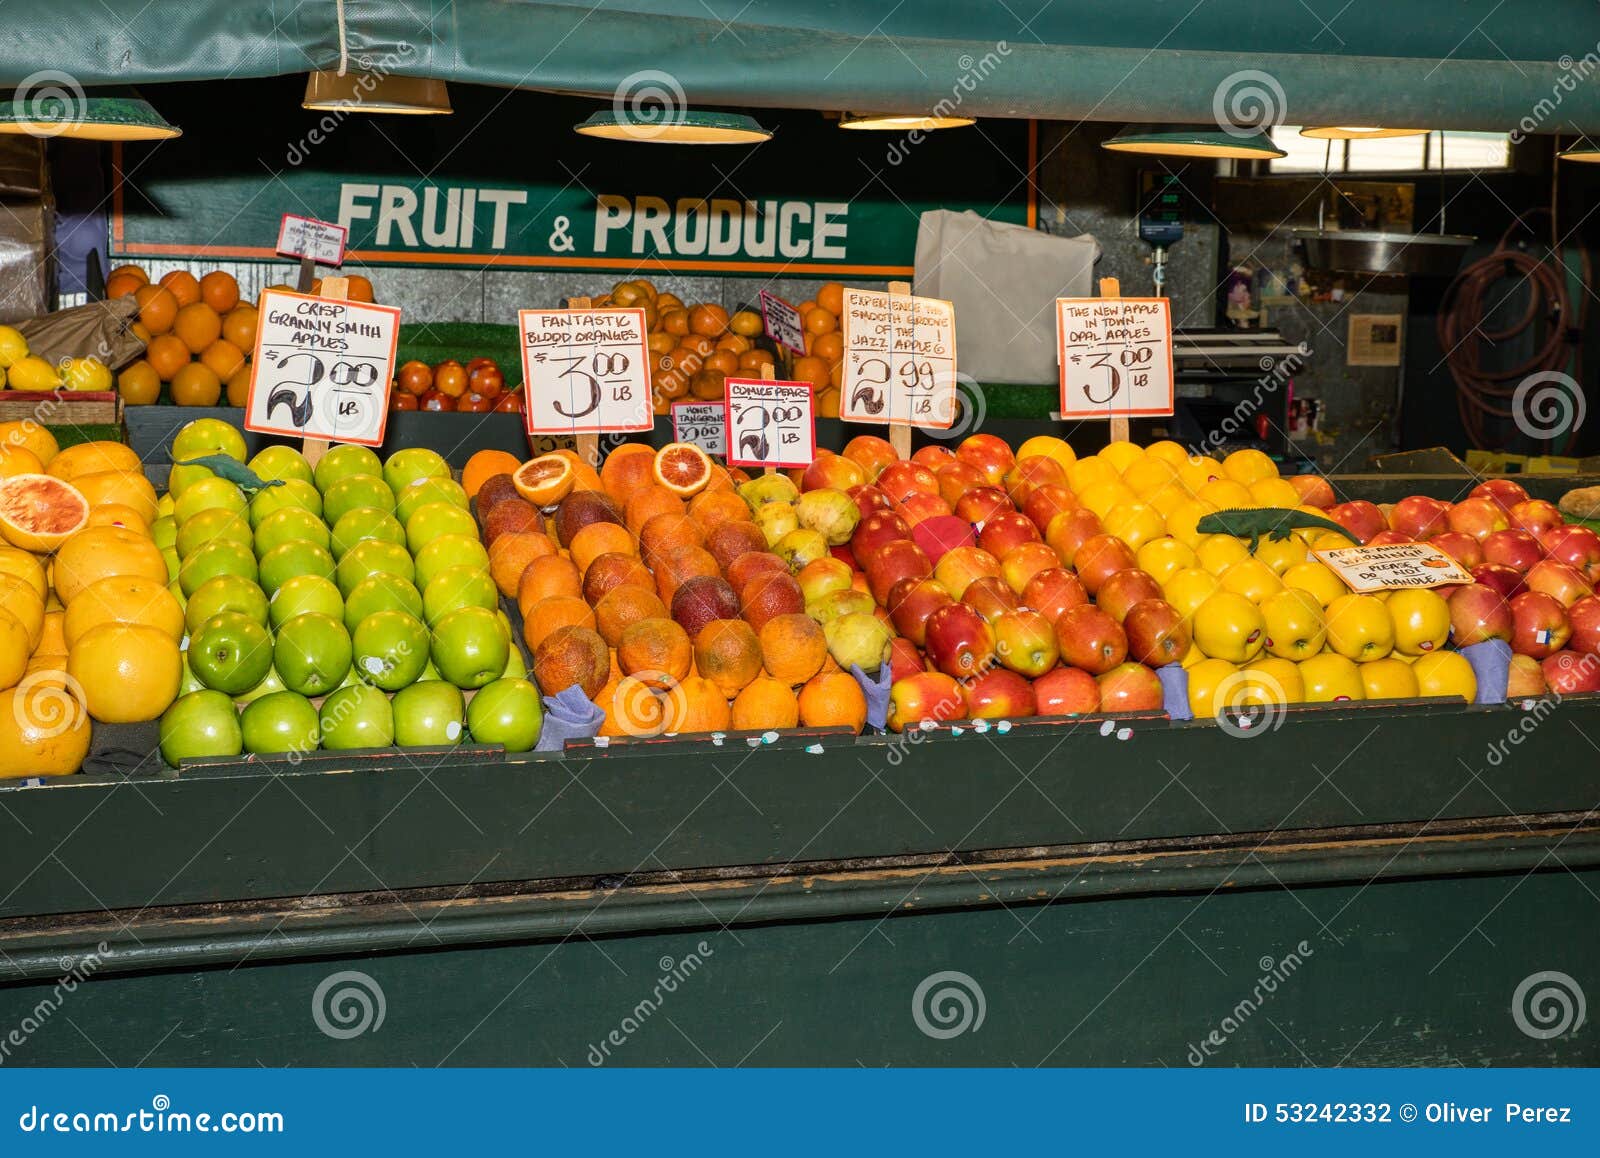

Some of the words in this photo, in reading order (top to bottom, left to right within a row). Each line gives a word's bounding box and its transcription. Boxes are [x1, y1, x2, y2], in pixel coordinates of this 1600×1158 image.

[338, 183, 528, 250] FRUIT
[548, 215, 576, 252] &
[593, 193, 849, 260] PRODUCE
[297, 302, 345, 318] CRISP
[1066, 307, 1089, 317] THE
[1093, 306, 1119, 316] NEW
[1123, 304, 1159, 314] APPLE
[268, 310, 332, 334] GRANNY
[335, 321, 381, 339] SMITH
[541, 315, 631, 328] FANTASTIC
[851, 309, 902, 324] SMOOTH
[906, 315, 949, 327] GROOVE
[1085, 319, 1097, 328] IN
[527, 332, 572, 344] BLOOD
[575, 329, 639, 342] ORANGES
[875, 324, 891, 335] OF
[895, 327, 914, 337] THE
[1069, 331, 1101, 342] OPAL
[1105, 327, 1151, 340] APPLES
[290, 331, 349, 350] APPLES
[852, 334, 889, 348] JAZZ
[1133, 373, 1148, 387] LB
[612, 385, 632, 401] LB
[732, 385, 773, 397] COMICE
[775, 386, 809, 398] PEARS
[338, 400, 360, 416] LB
[686, 406, 713, 415] HONEY
[915, 399, 932, 414] LB
[706, 440, 718, 449] LB
[782, 432, 800, 445] LB
[1368, 561, 1413, 572] PLEASE
[1393, 567, 1422, 576] NOT
